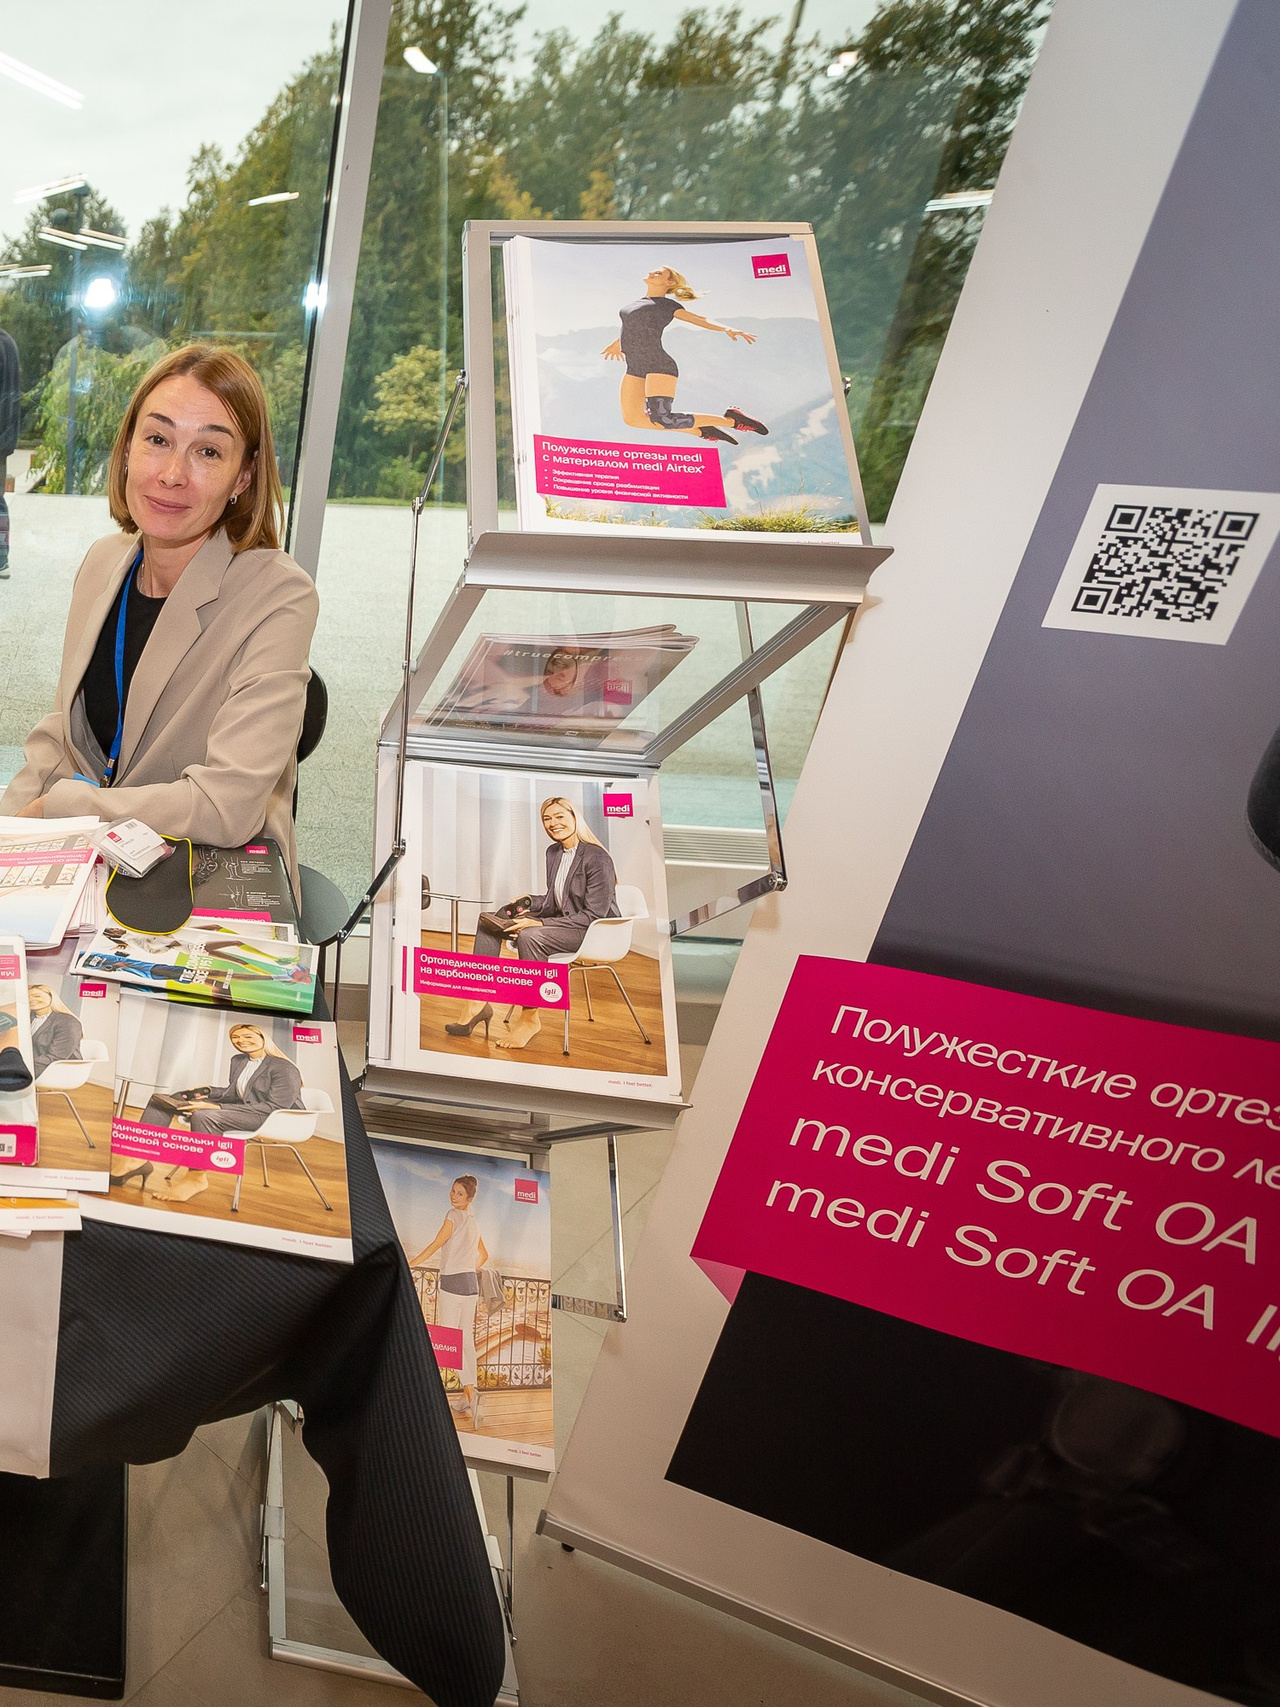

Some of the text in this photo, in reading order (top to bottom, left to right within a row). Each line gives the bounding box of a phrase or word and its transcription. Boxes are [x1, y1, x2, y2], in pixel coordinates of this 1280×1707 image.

[757, 262, 787, 275] medi
[542, 441, 703, 462] Полужесткие ортезы medi
[552, 455, 629, 469] материалом
[632, 462, 663, 472] medi
[606, 803, 631, 814] medi
[420, 953, 558, 978] Ортопедические стельки igli
[420, 966, 533, 986] на карбоновой основе
[82, 989, 104, 997] medi
[544, 988, 557, 996] igli
[295, 1032, 319, 1042] medi
[830, 1005, 1137, 1098] Полужесткие
[812, 1060, 1225, 1172] консервативного
[162, 1142, 204, 1154] основе
[171, 1133, 214, 1147] стельки
[217, 1140, 233, 1150] igli
[516, 1190, 536, 1200] medi
[789, 1117, 1257, 1264] medi Soft OA
[766, 1180, 930, 1247] medi
[945, 1225, 1096, 1295] Soft
[1118, 1269, 1214, 1330] OA
